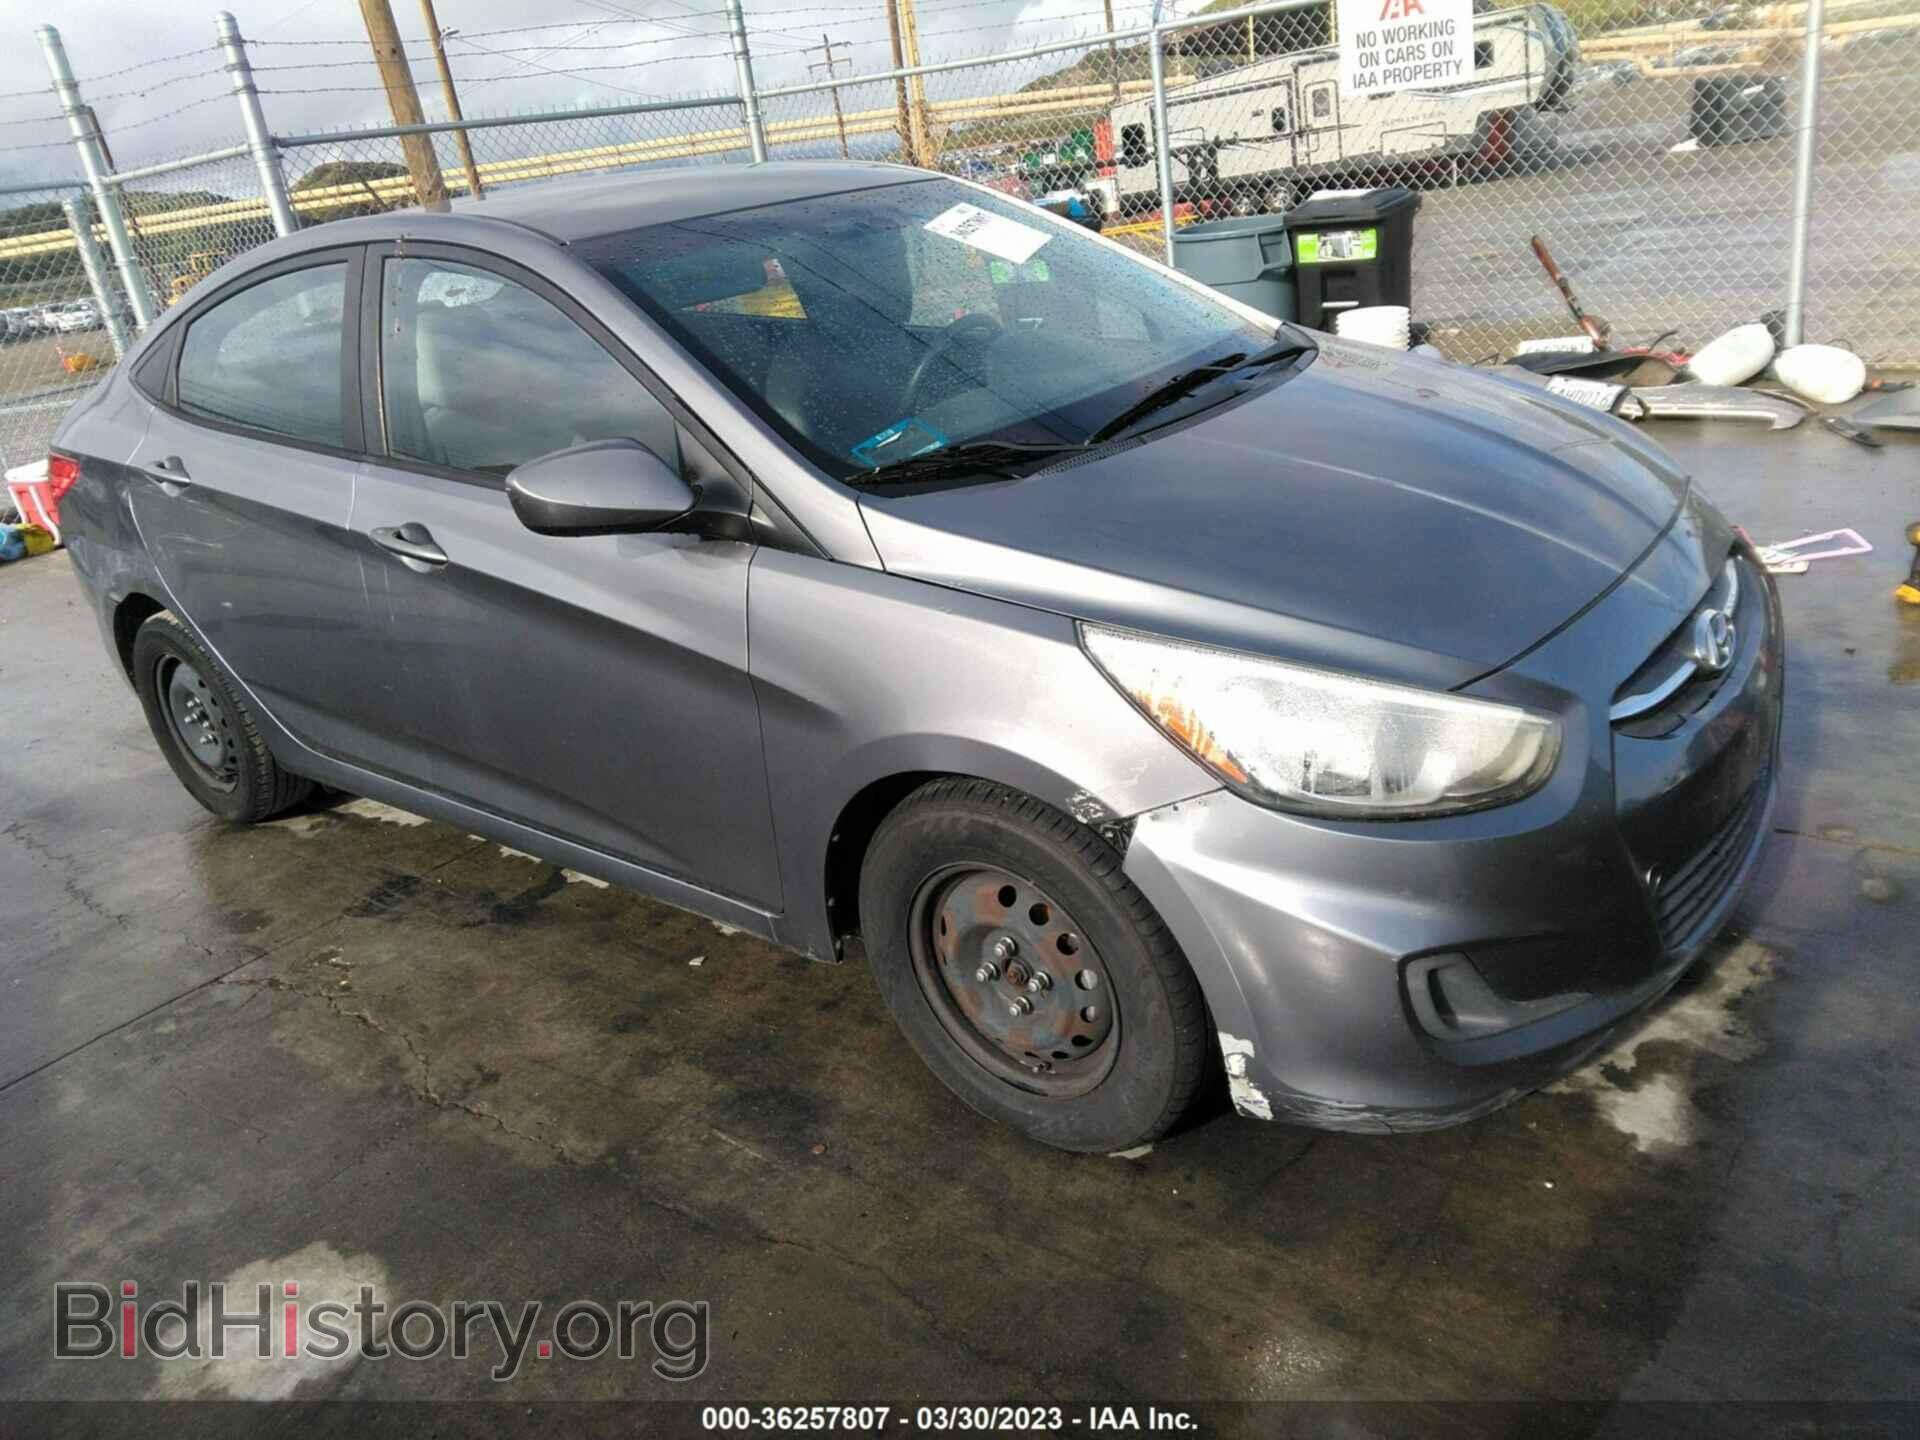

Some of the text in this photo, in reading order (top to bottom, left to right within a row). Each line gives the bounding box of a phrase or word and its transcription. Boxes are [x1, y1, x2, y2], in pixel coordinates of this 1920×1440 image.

[1356, 19, 1456, 48] NO WORKING
[1359, 40, 1454, 68] ON CARS ON
[1353, 59, 1463, 88] IAA PROPERTY
